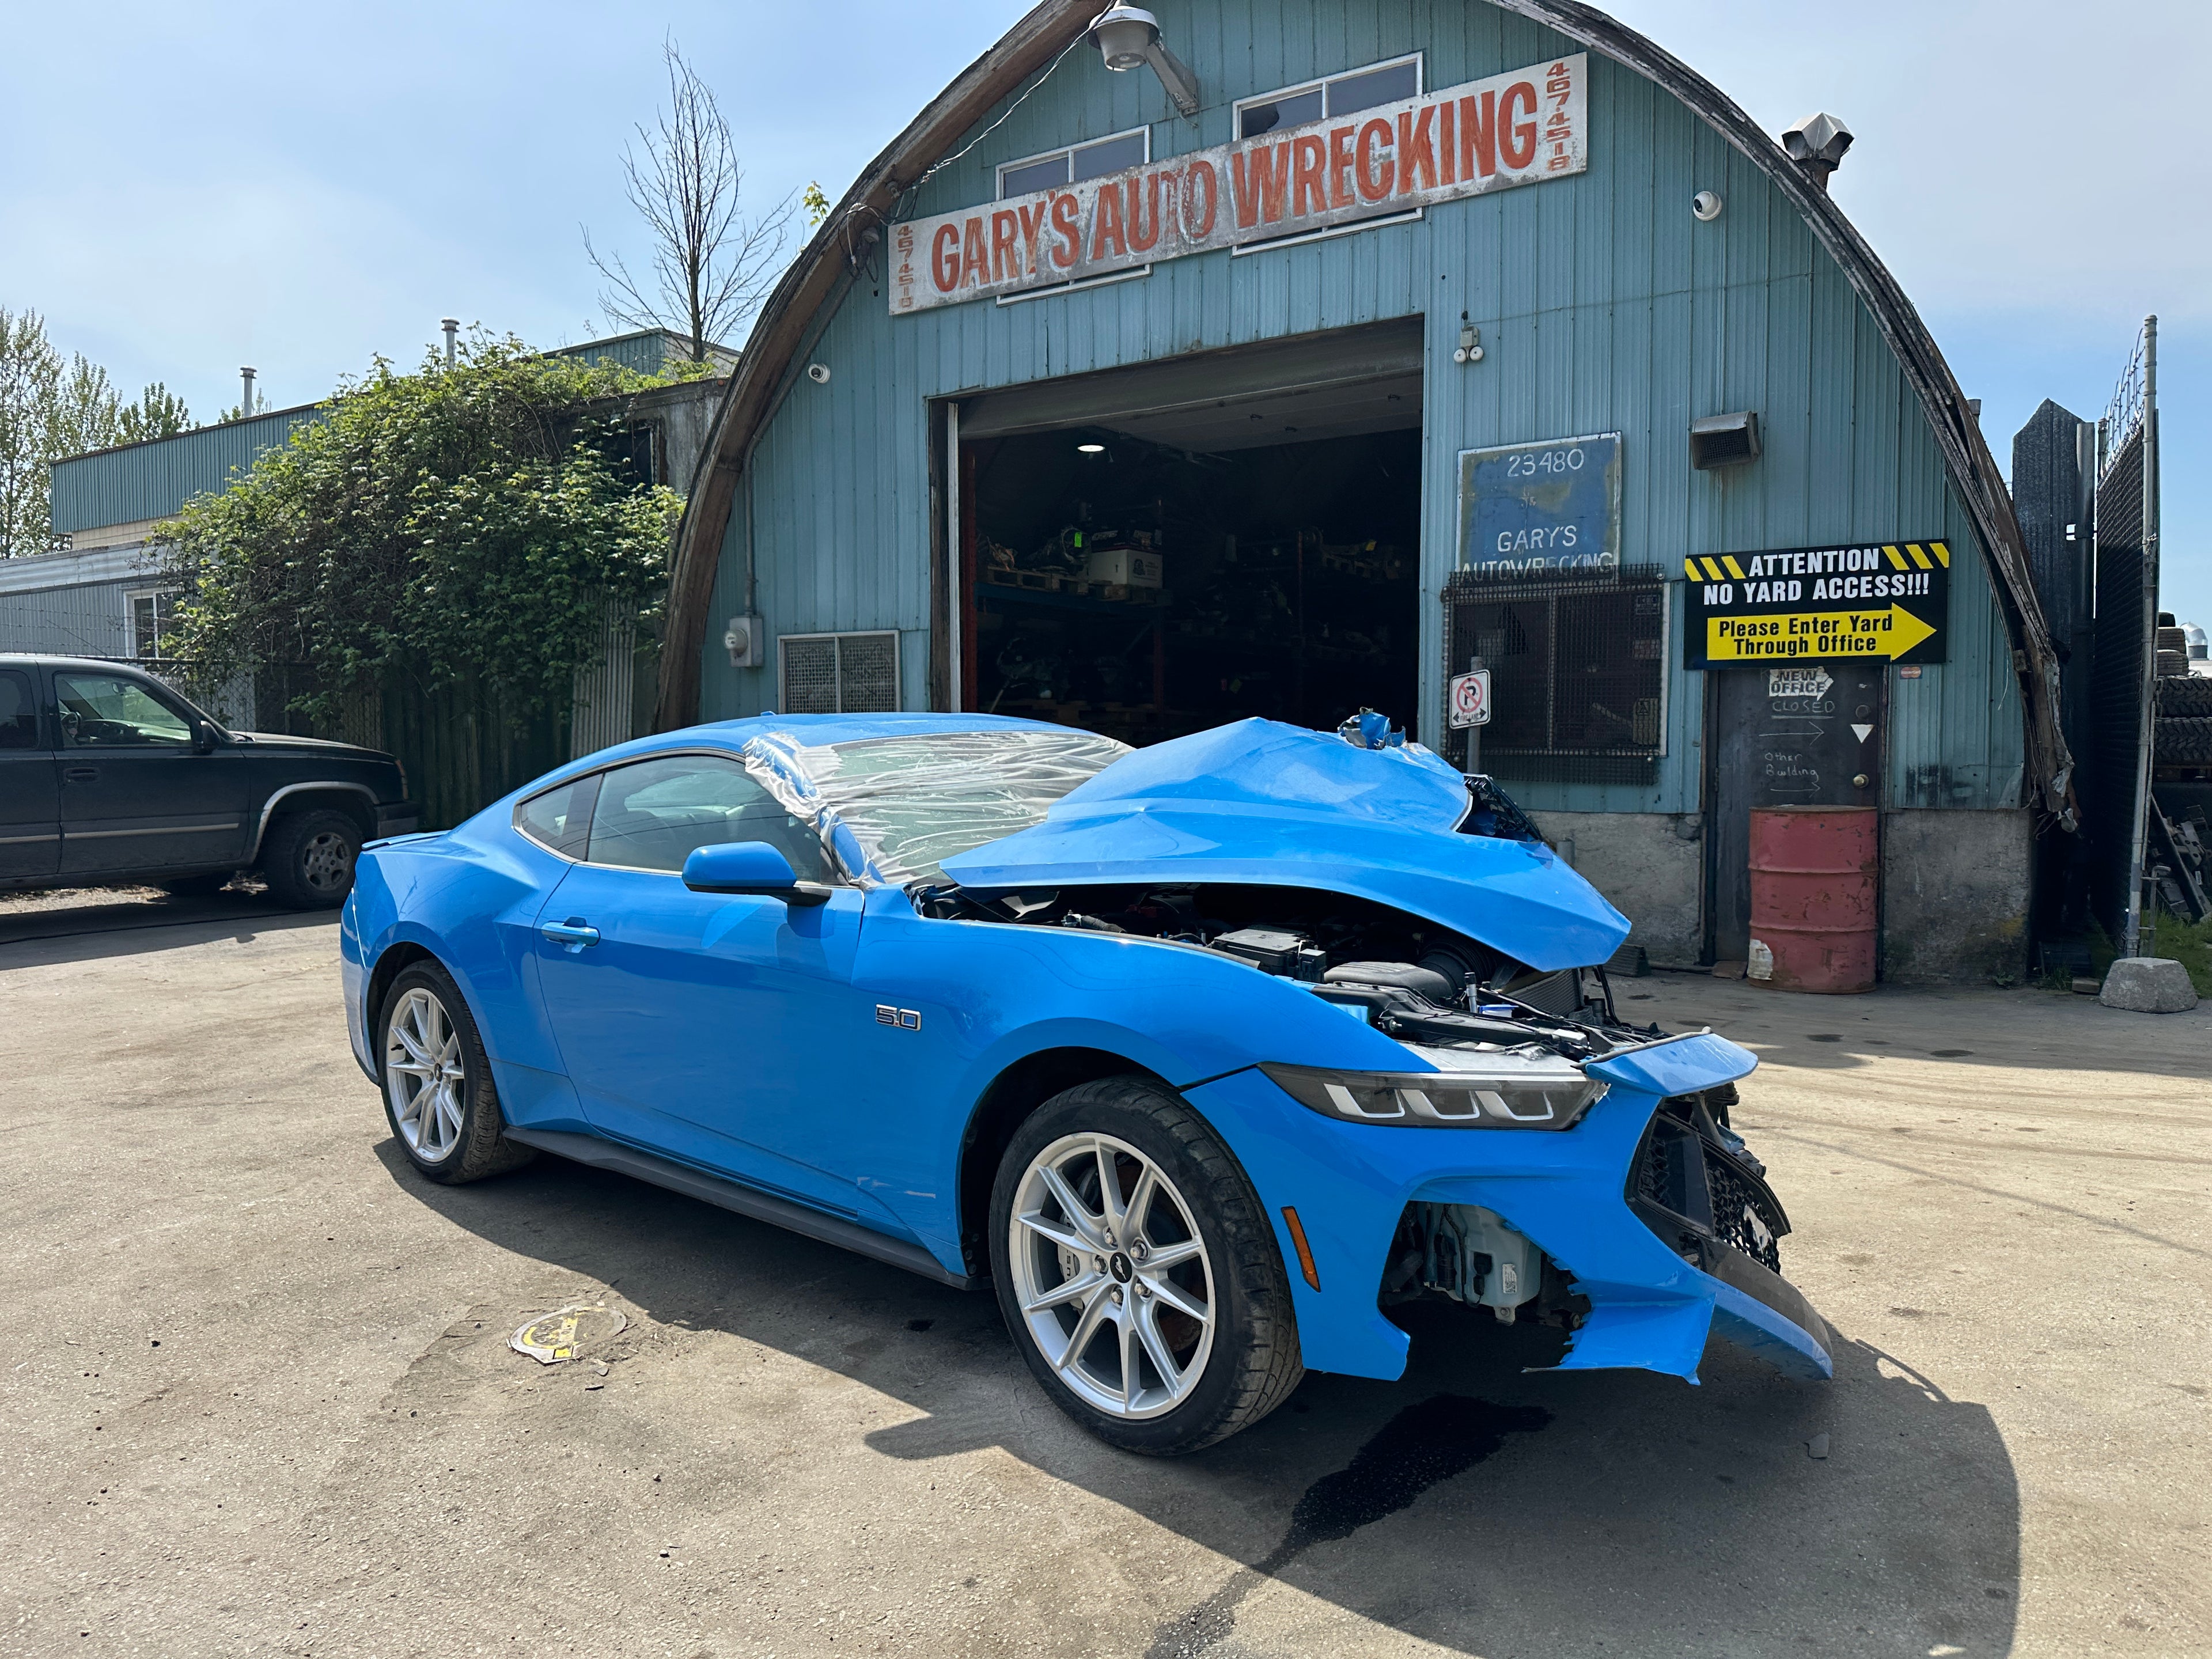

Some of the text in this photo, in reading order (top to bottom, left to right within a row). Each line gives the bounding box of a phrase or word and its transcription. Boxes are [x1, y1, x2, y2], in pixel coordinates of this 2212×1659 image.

[931, 81, 1538, 293] GARY'S AUTO WRECKING
[1507, 448, 1585, 478] 23480
[1497, 525, 1577, 552] GARY'S
[1749, 548, 1879, 577] ATTENTION
[1703, 573, 1929, 605] NO YARD ACCESS!!!
[1719, 614, 1892, 637] Please Enter Yard
[1734, 635, 1876, 656] Through Office
[1771, 681, 1826, 694] OFFICE
[1779, 671, 1816, 681] NEW
[1772, 700, 1835, 713] CLOSED
[875, 1003, 922, 1031] 5.0
